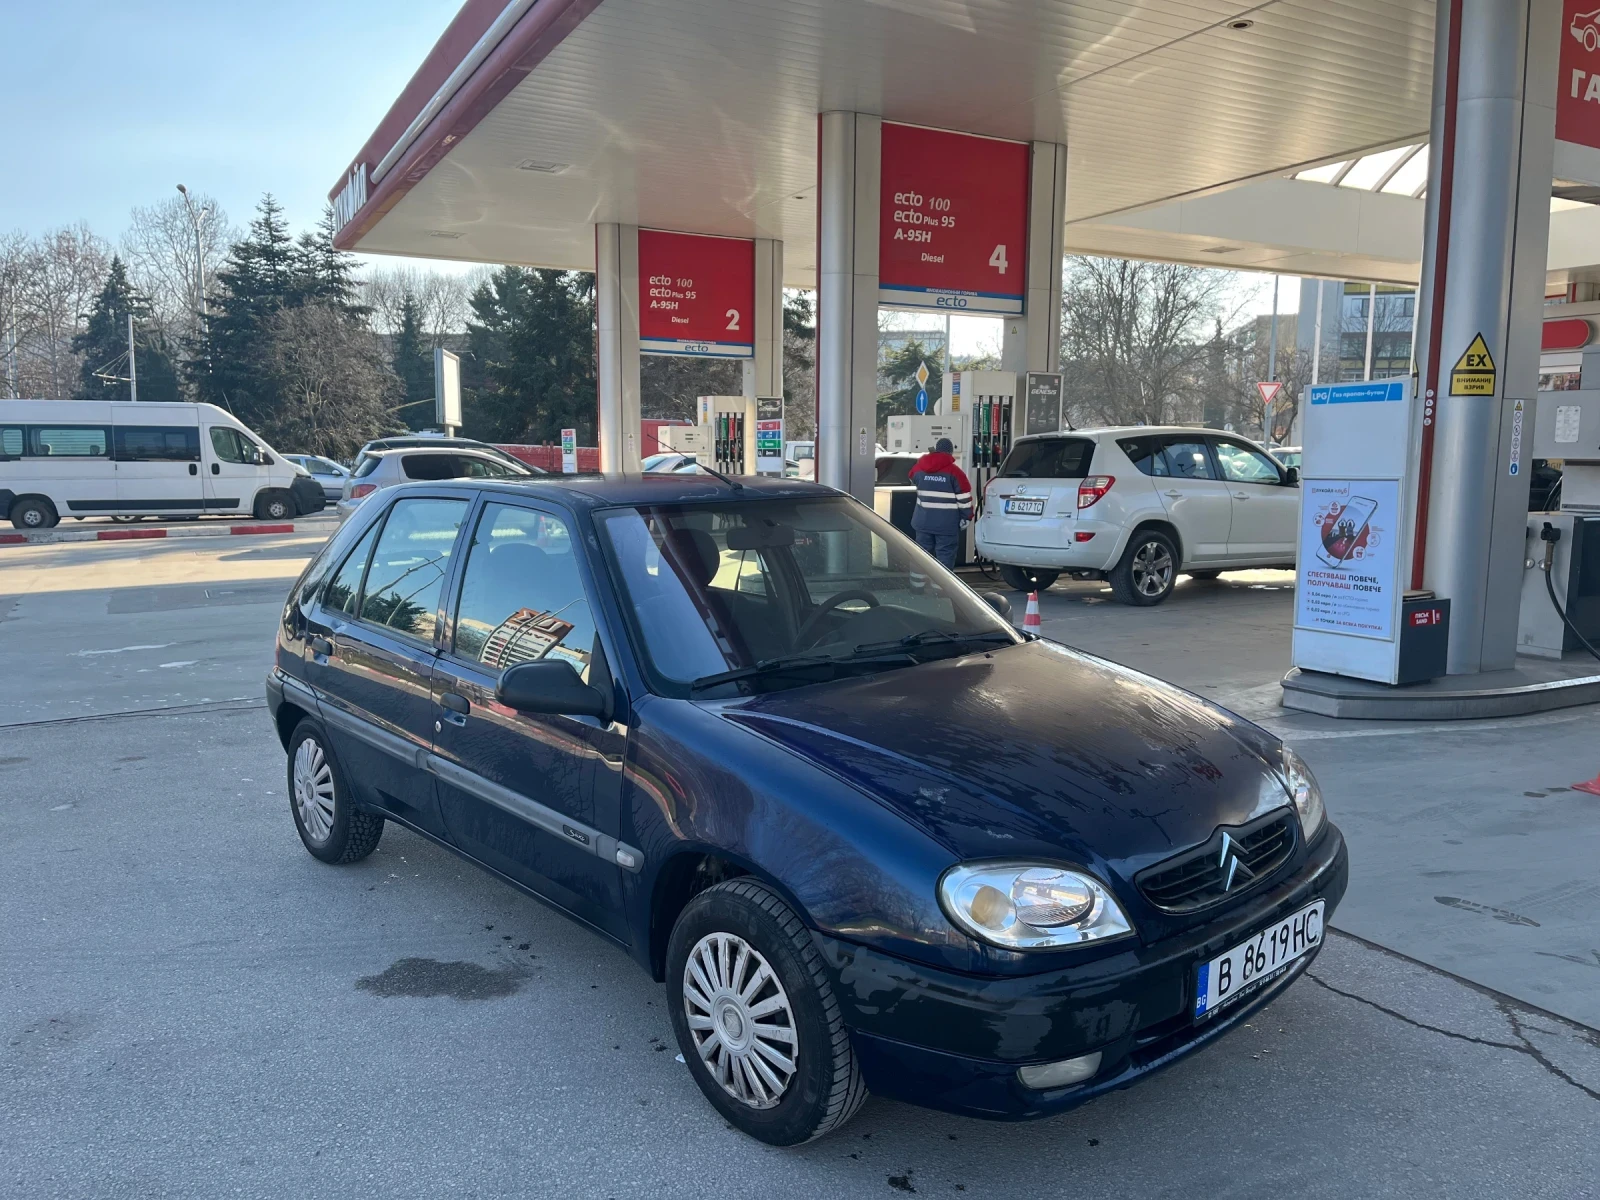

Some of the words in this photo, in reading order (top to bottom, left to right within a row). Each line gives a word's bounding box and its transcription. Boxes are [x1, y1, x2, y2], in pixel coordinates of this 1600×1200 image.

[894, 191, 923, 206] ecto
[928, 197, 951, 212] 100
[894, 209, 922, 224] ecto
[923, 216, 938, 226] Plus
[941, 216, 955, 228] 95
[894, 228, 932, 242] A-95H
[921, 252, 944, 263] Diesel
[988, 244, 1008, 274] 4
[650, 274, 671, 286] ecto
[676, 278, 692, 288] 100
[650, 287, 671, 298] ecto
[686, 291, 696, 299] 95
[650, 300, 678, 310] A-95H
[936, 296, 967, 307] ecto
[726, 309, 739, 330] 2
[685, 344, 708, 352] ecto
[1466, 354, 1487, 367] EX
[1312, 392, 1327, 400] LPG
[924, 475, 946, 483] ЛУКОЙЛ
[1010, 502, 1016, 510] B
[1018, 502, 1032, 511] 6217
[1307, 571, 1346, 580] СПЕСТЯВАШ
[1348, 575, 1379, 584] ПОВЕЧЕ,
[1307, 580, 1350, 590] ПОЛУЧАВАШ
[1353, 584, 1381, 592] ПОВЕЧЕ
[1218, 958, 1231, 997] B
[1196, 995, 1206, 1008] BG
